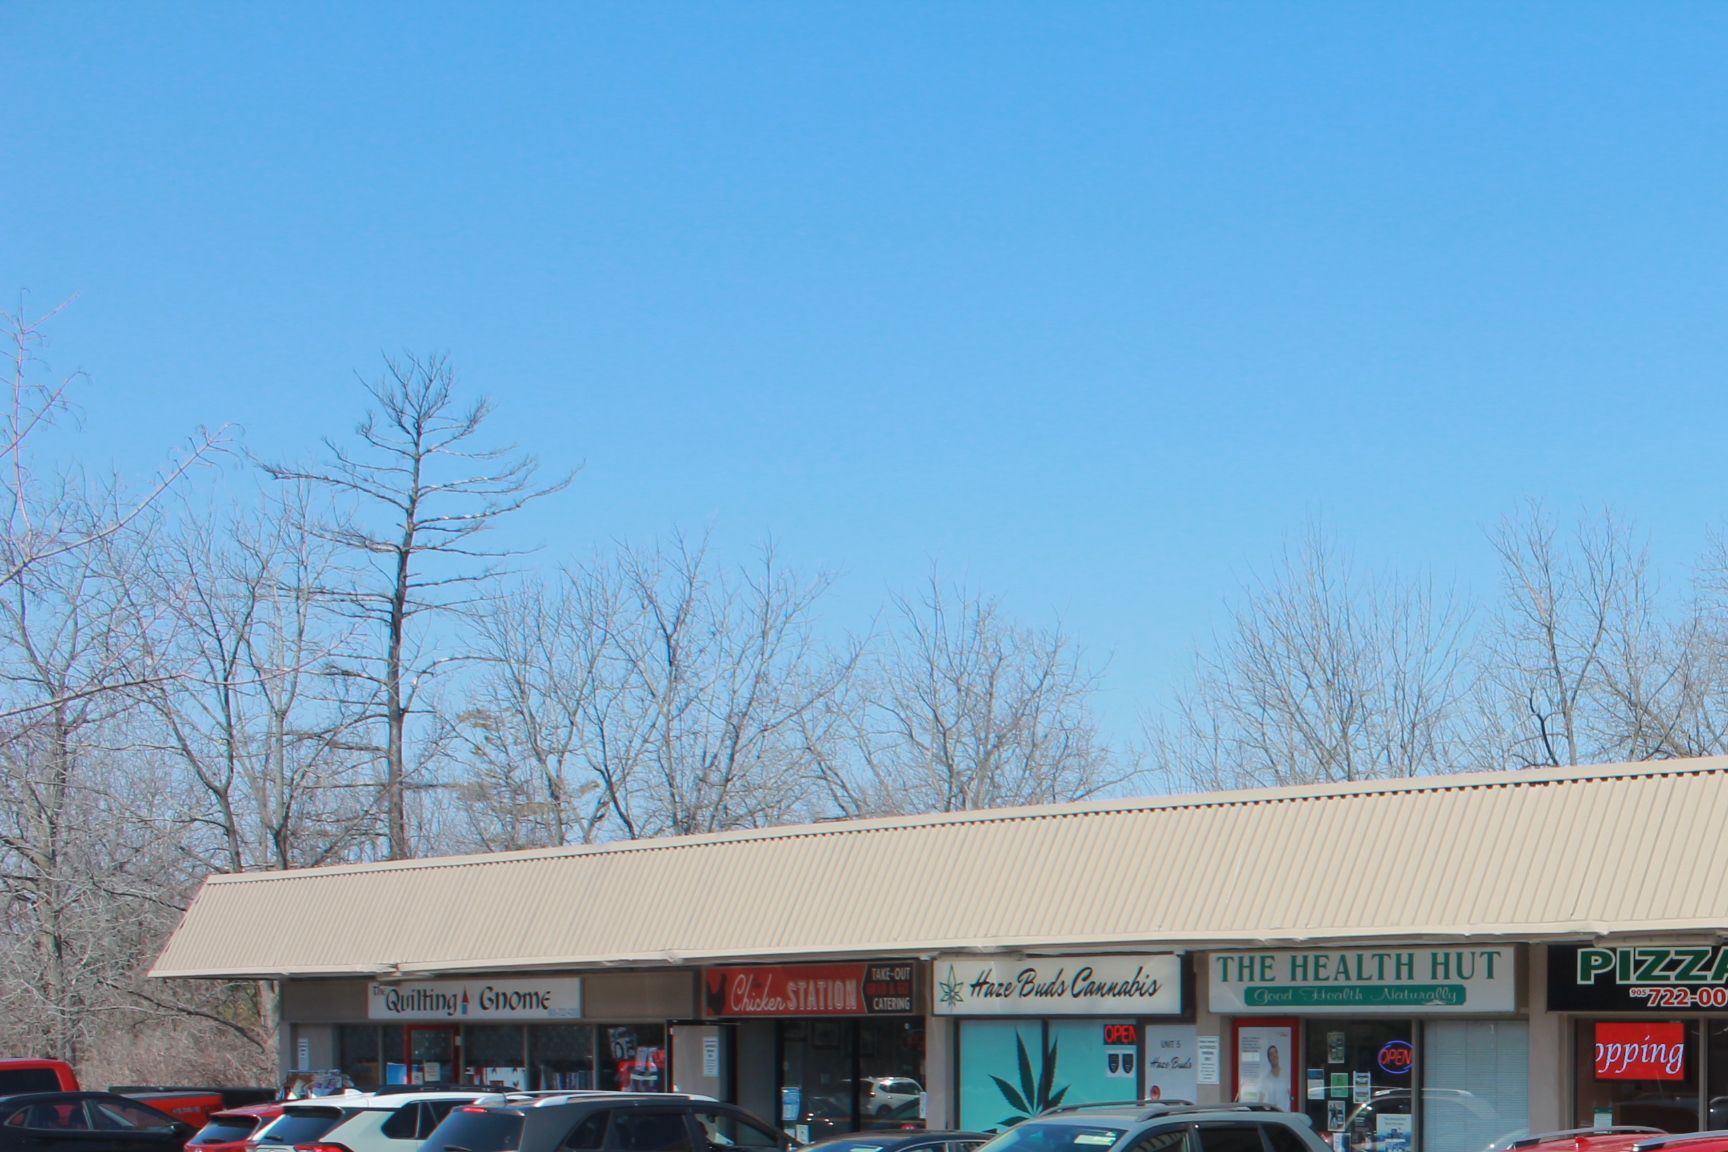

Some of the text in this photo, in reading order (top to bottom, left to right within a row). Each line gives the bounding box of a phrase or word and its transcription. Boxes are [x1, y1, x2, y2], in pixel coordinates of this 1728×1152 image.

[872, 967, 911, 981] TAKE-OUT
[1216, 951, 1502, 982] THE HEALTH HUT
[731, 973, 786, 1011] Chicken
[787, 980, 858, 1011] STATION
[970, 966, 1162, 999] Haze Buds Cannabis
[385, 986, 551, 1017] Quilting Gnome
[1254, 987, 1457, 1005] Good Health Naturally
[1630, 987, 1648, 998] 905
[873, 997, 911, 1011] CATERING
[1104, 1024, 1136, 1044] OPEN
[1380, 1049, 1413, 1066] OPEN
